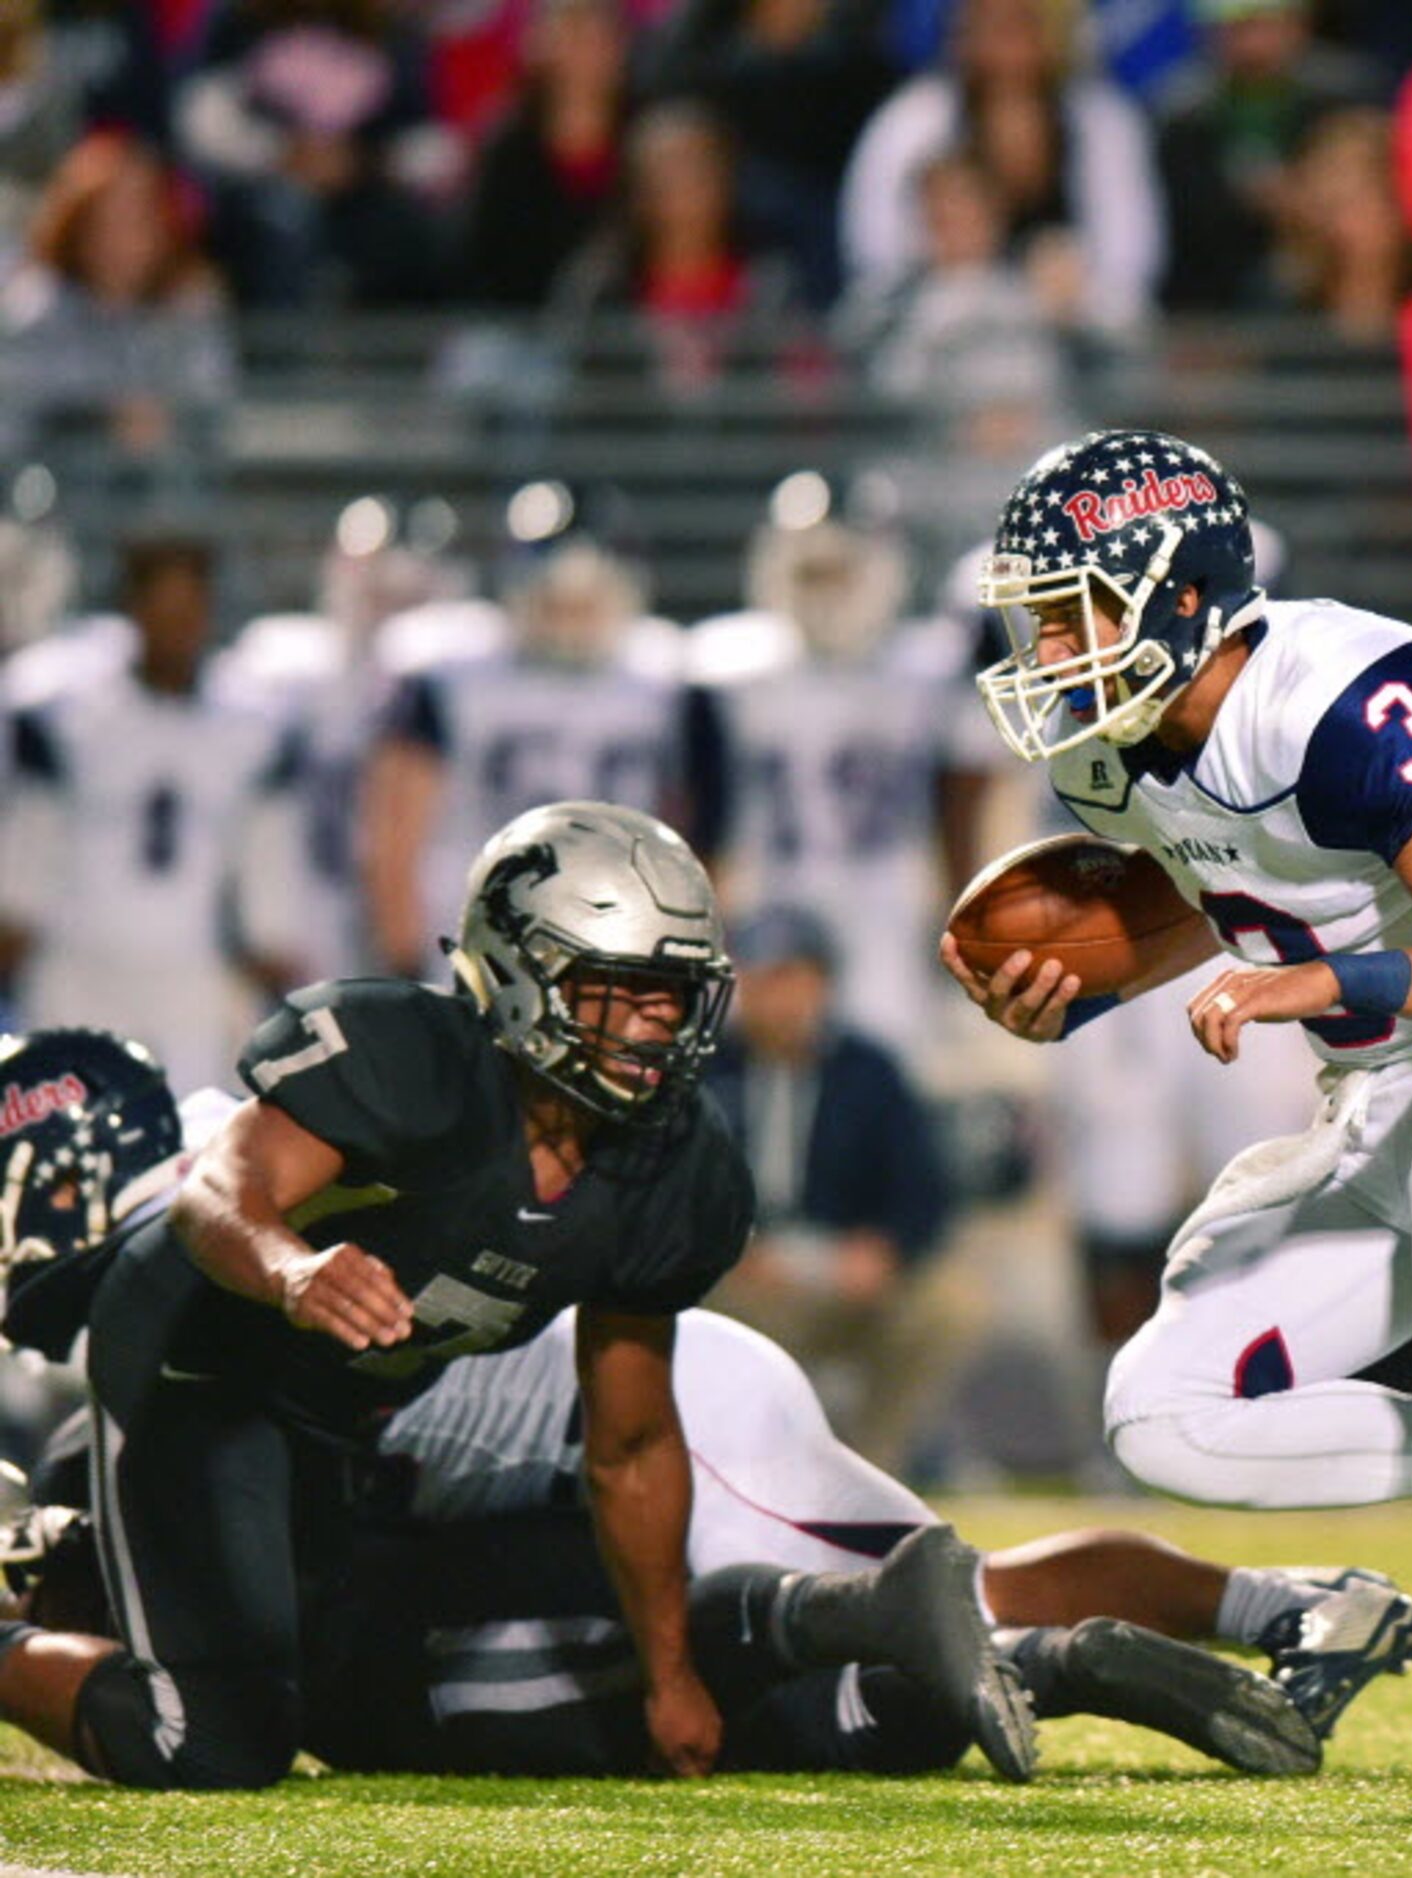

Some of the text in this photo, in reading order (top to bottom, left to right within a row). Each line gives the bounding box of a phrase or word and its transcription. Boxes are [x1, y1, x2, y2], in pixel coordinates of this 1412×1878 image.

[1062, 468, 1219, 541] Raiders
[251, 1006, 349, 1093] 7
[0, 1073, 87, 1136] ders
